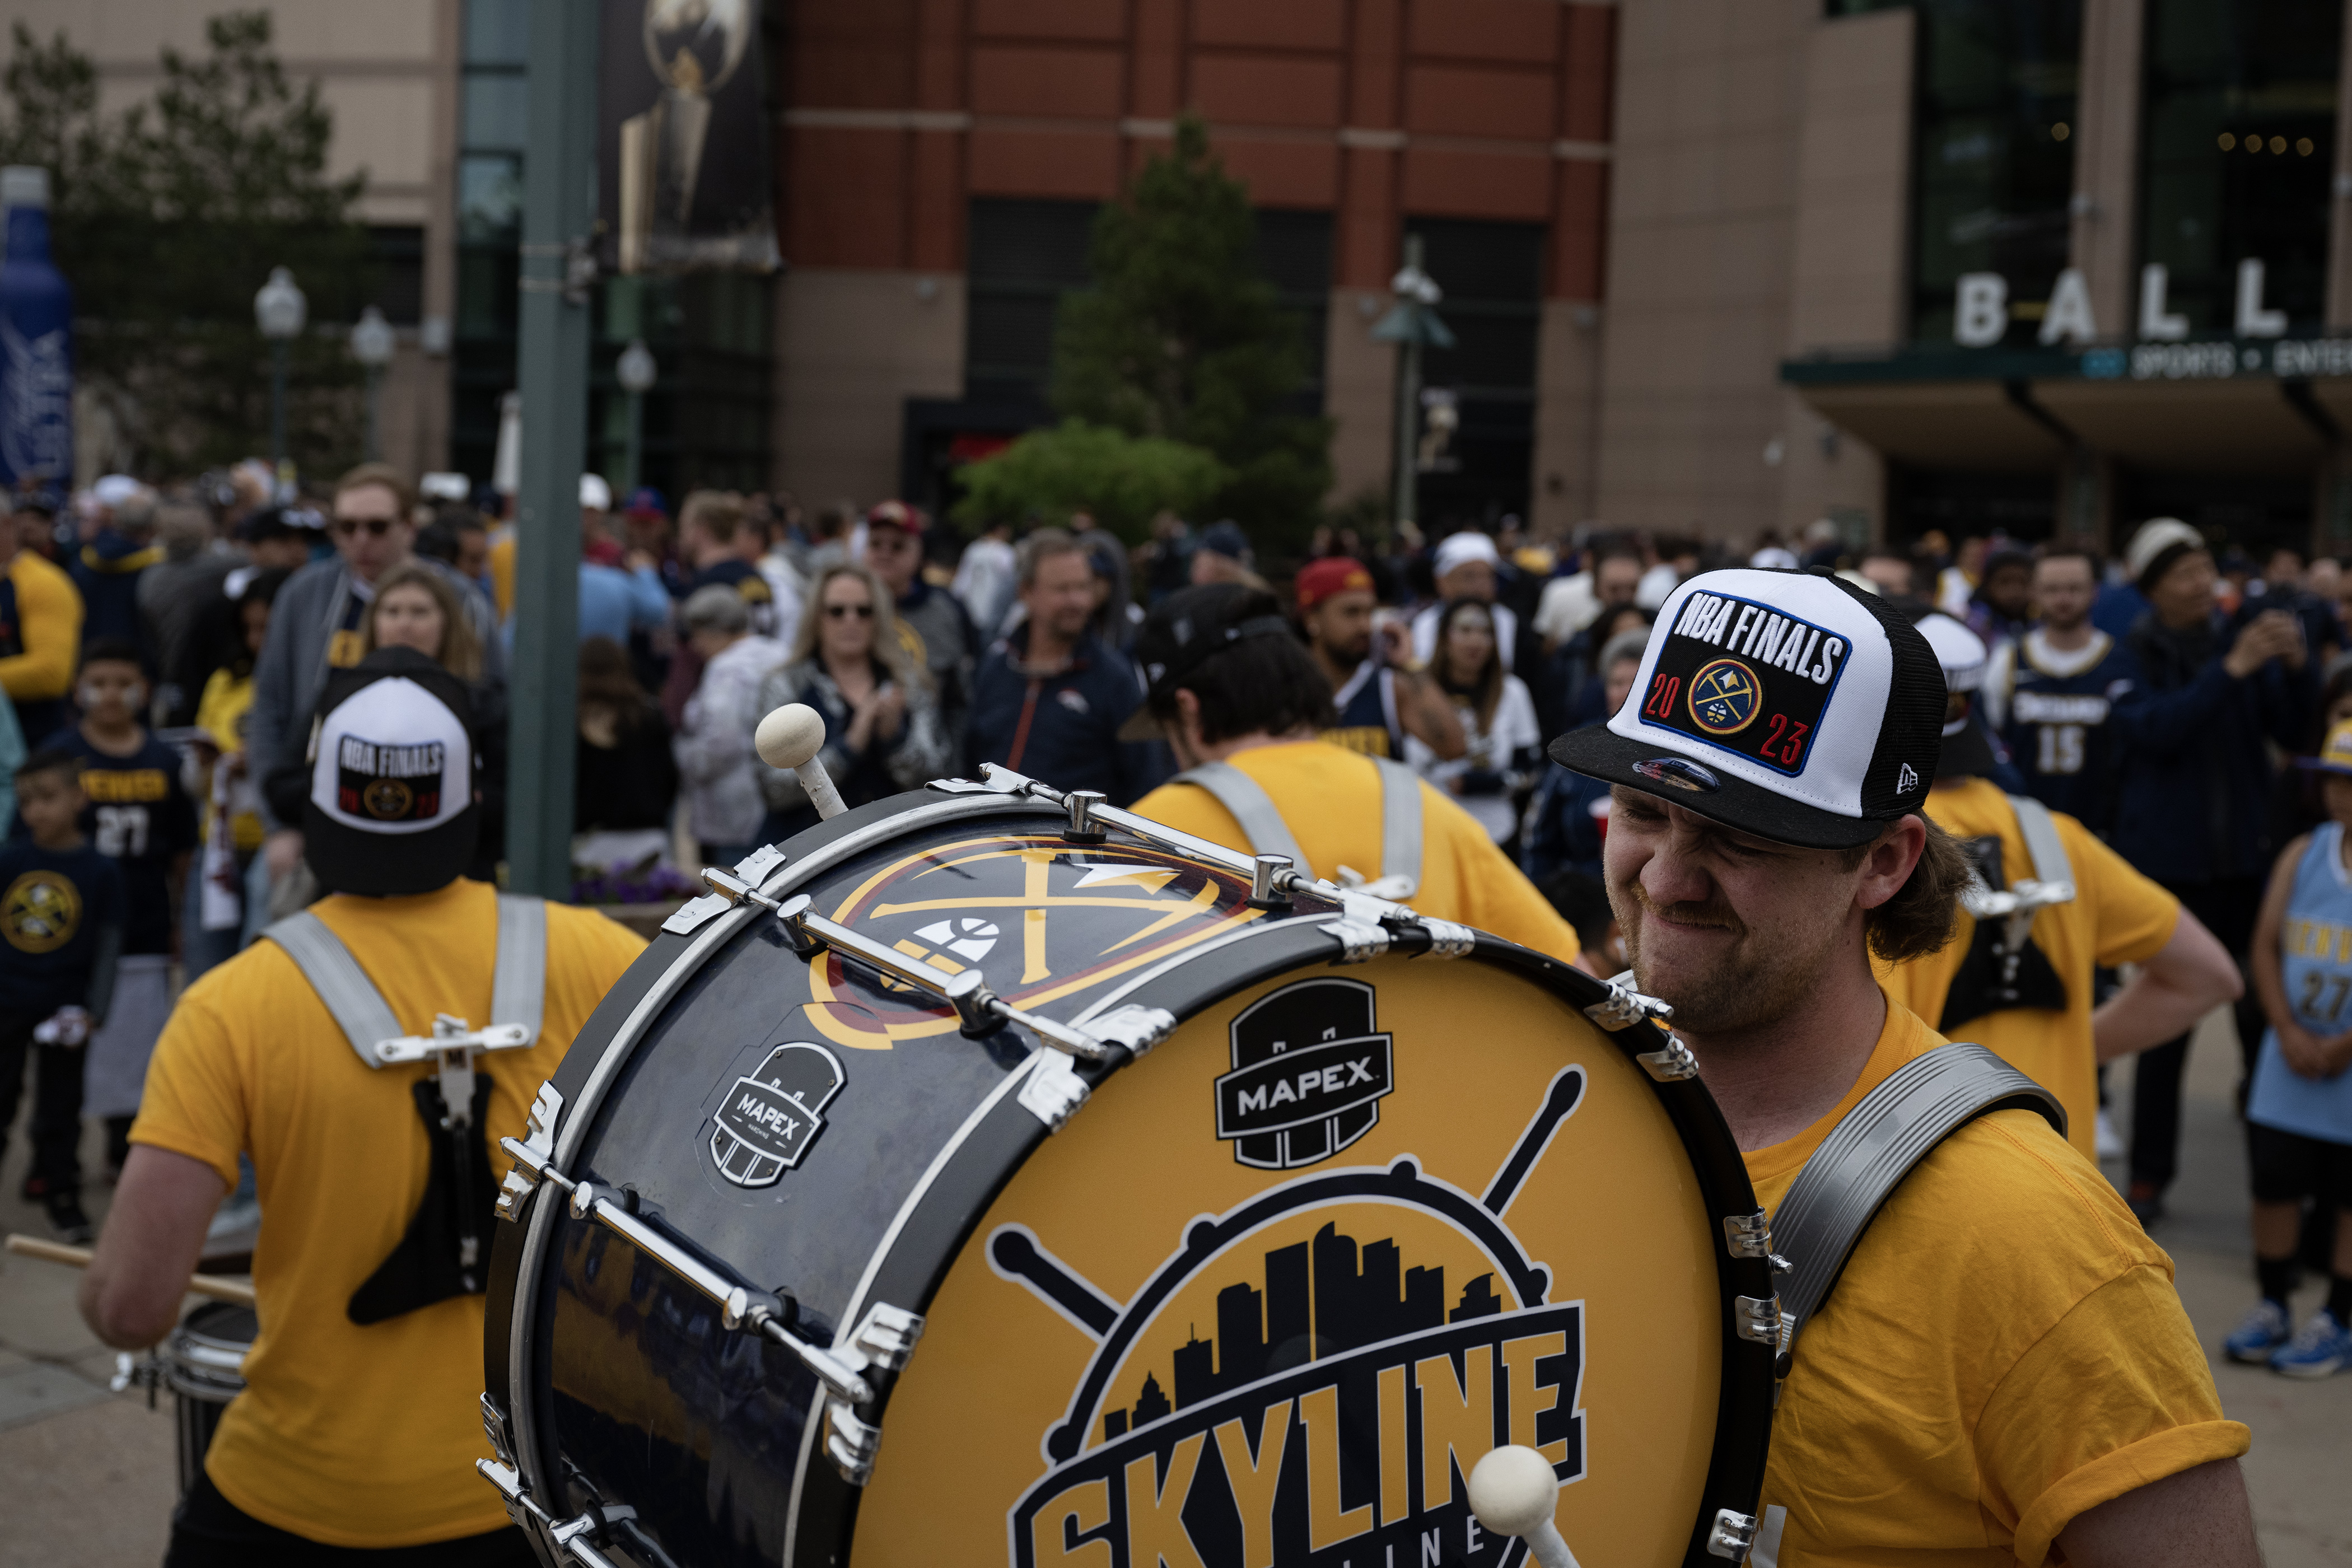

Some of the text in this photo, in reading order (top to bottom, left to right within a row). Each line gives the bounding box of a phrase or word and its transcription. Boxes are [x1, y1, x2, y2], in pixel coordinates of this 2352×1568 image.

[1953, 256, 2289, 348] BALL
[2130, 343, 2236, 380] SPORTS
[1674, 592, 1844, 685] NBA FINALS
[1645, 673, 1809, 766] 20 23
[339, 738, 442, 779] NBA FINALS
[2037, 725, 2086, 774] 15
[95, 804, 151, 858] 27
[2300, 971, 2351, 1021] 27
[1238, 1055, 1374, 1117] MAPEX
[736, 1093, 801, 1141] MAPEX
[1031, 1329, 1568, 1568] SKYLINE
[1343, 1514, 1484, 1568] INE
